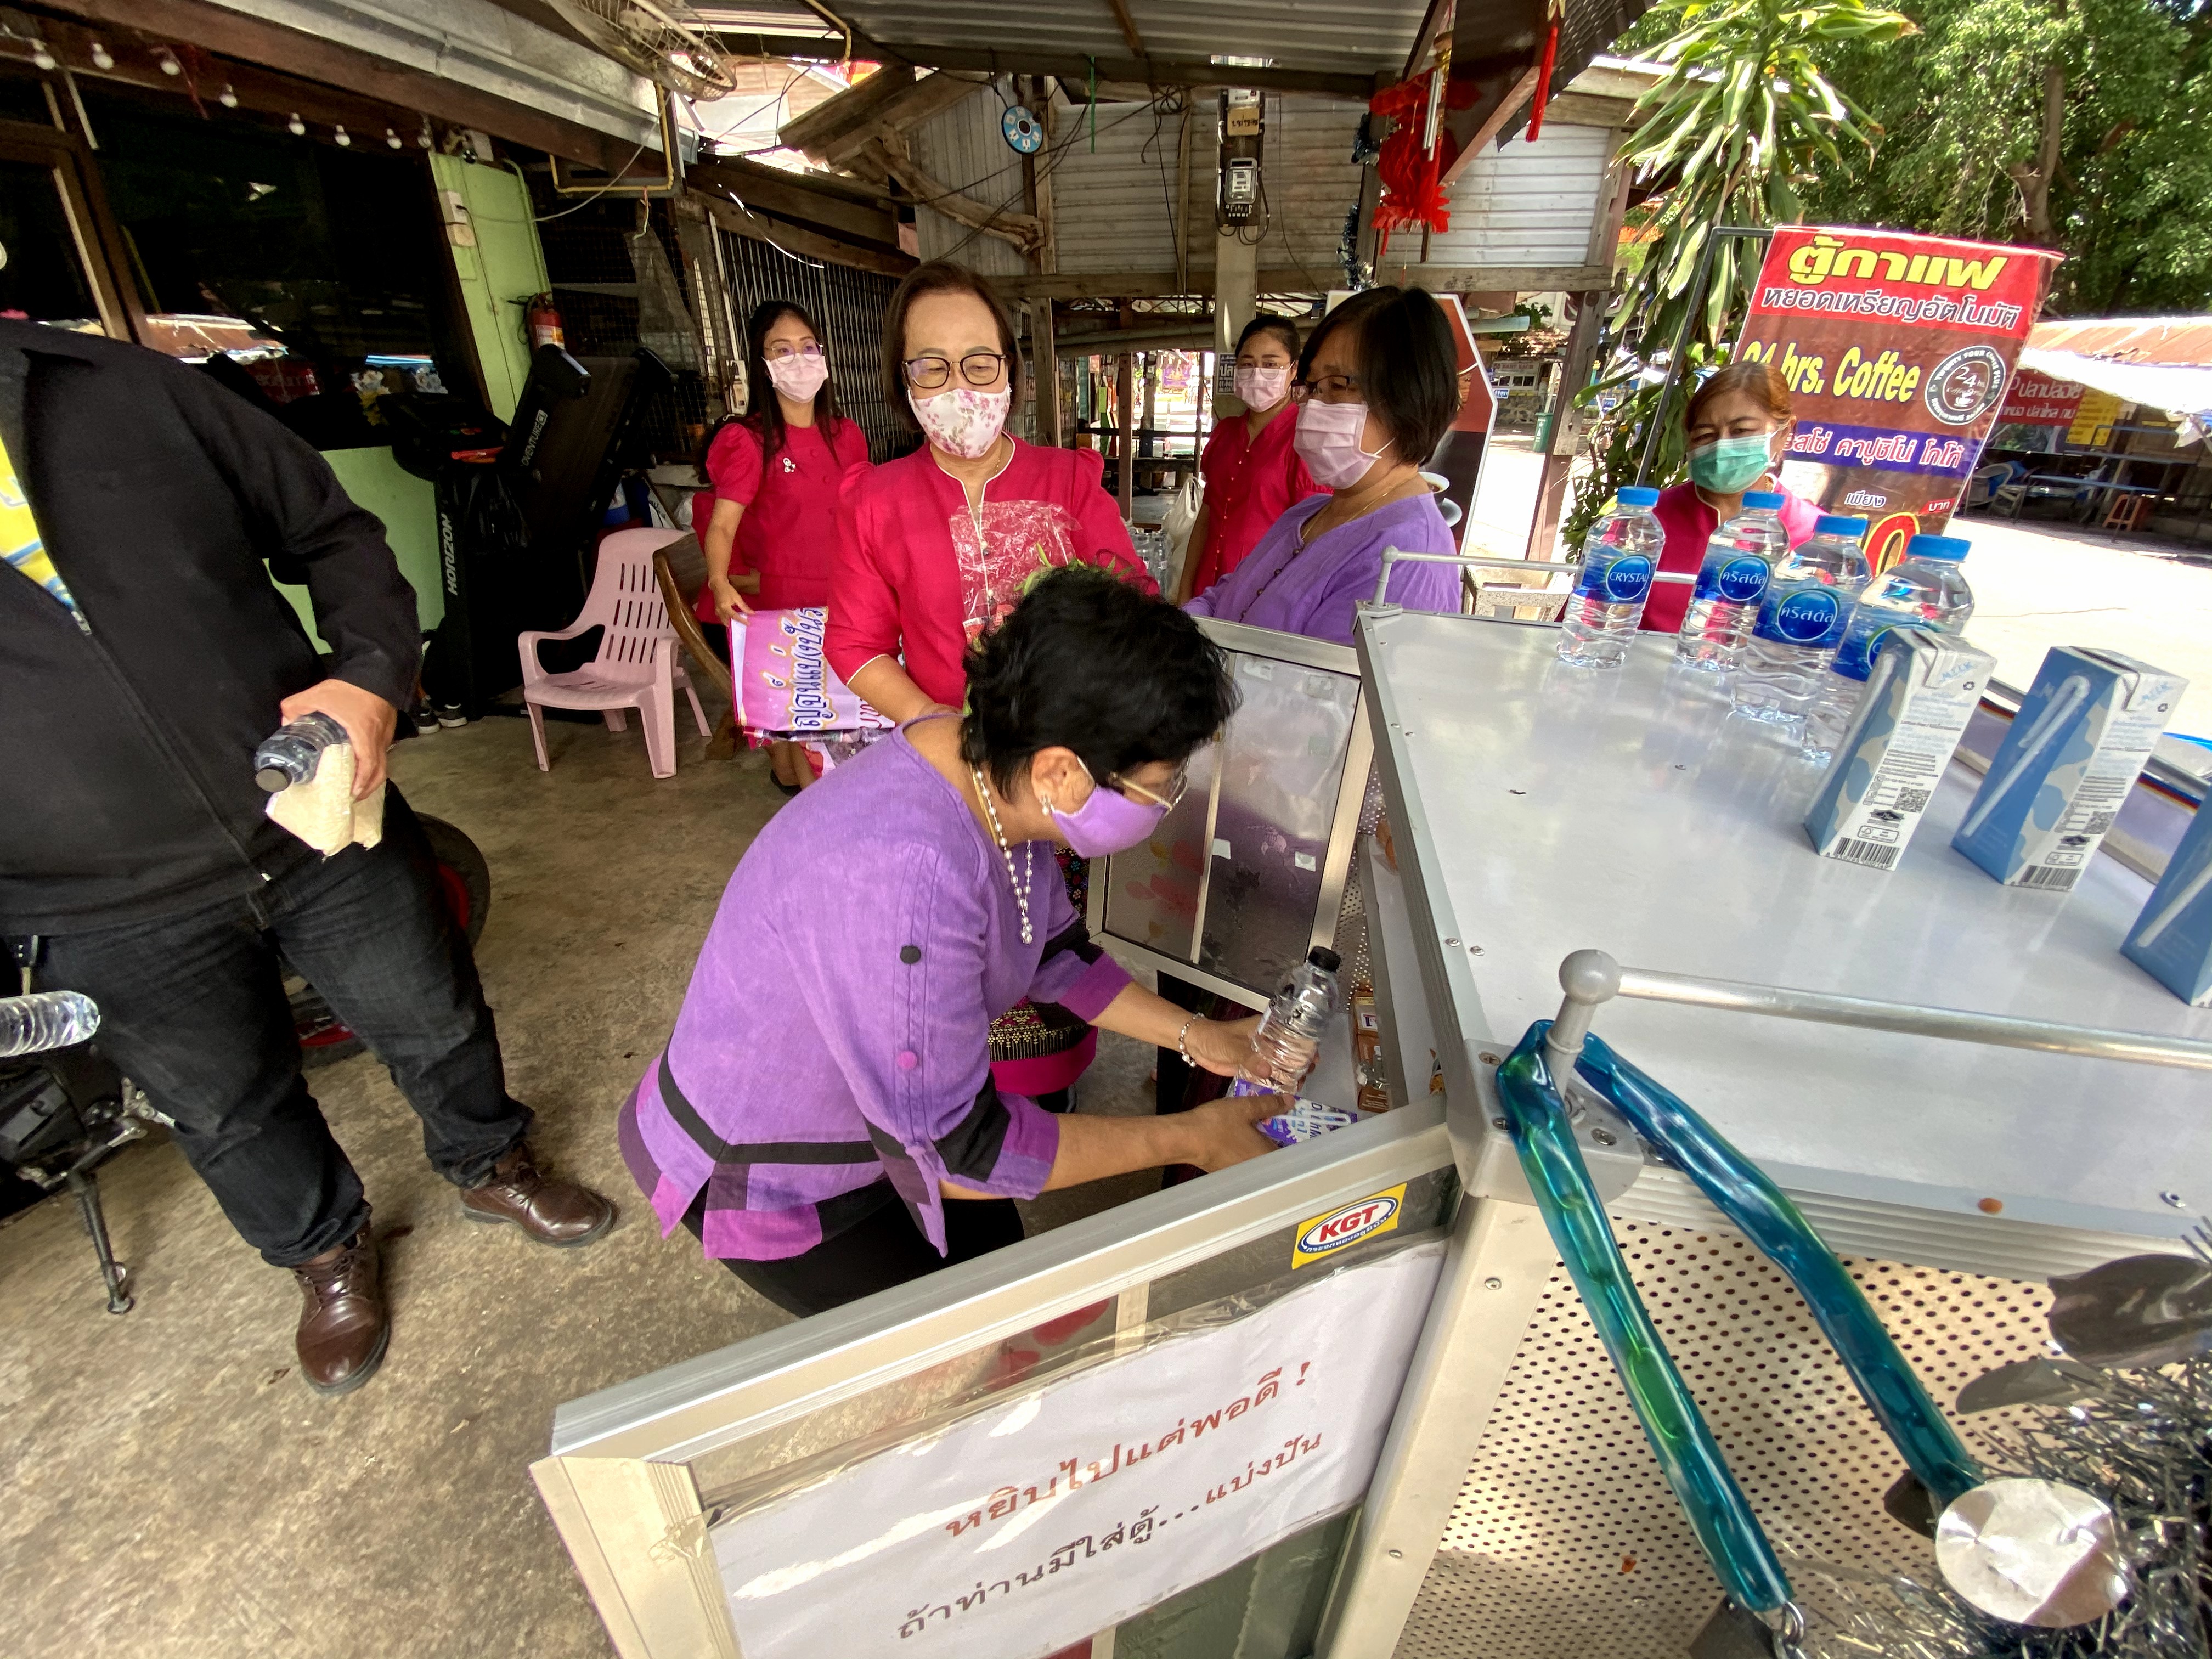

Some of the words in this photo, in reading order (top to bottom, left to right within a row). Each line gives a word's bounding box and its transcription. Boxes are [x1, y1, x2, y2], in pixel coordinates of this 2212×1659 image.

[1788, 235, 2008, 290] ตู้กาแฟ
[1762, 287, 2021, 329] หยอดเหรียญอัตโนมัติ
[1781, 342, 1825, 394] hrs.
[1833, 346, 1920, 402] Coffee
[1955, 366, 1977, 388] 24
[521, 424, 542, 467] DVENTURE
[1834, 435, 1917, 466] คาปูชิโน่
[1919, 439, 1965, 468] โกโก้
[1844, 490, 1887, 508] เพียง
[1928, 501, 1951, 512] บาท
[441, 512, 458, 596] HORIZON
[1722, 571, 1766, 585] คริสตัล
[1780, 606, 1834, 623] คริสตัล
[1319, 1204, 1379, 1242] KGT
[946, 1368, 1283, 1537] หยิบไปแต่พอดี
